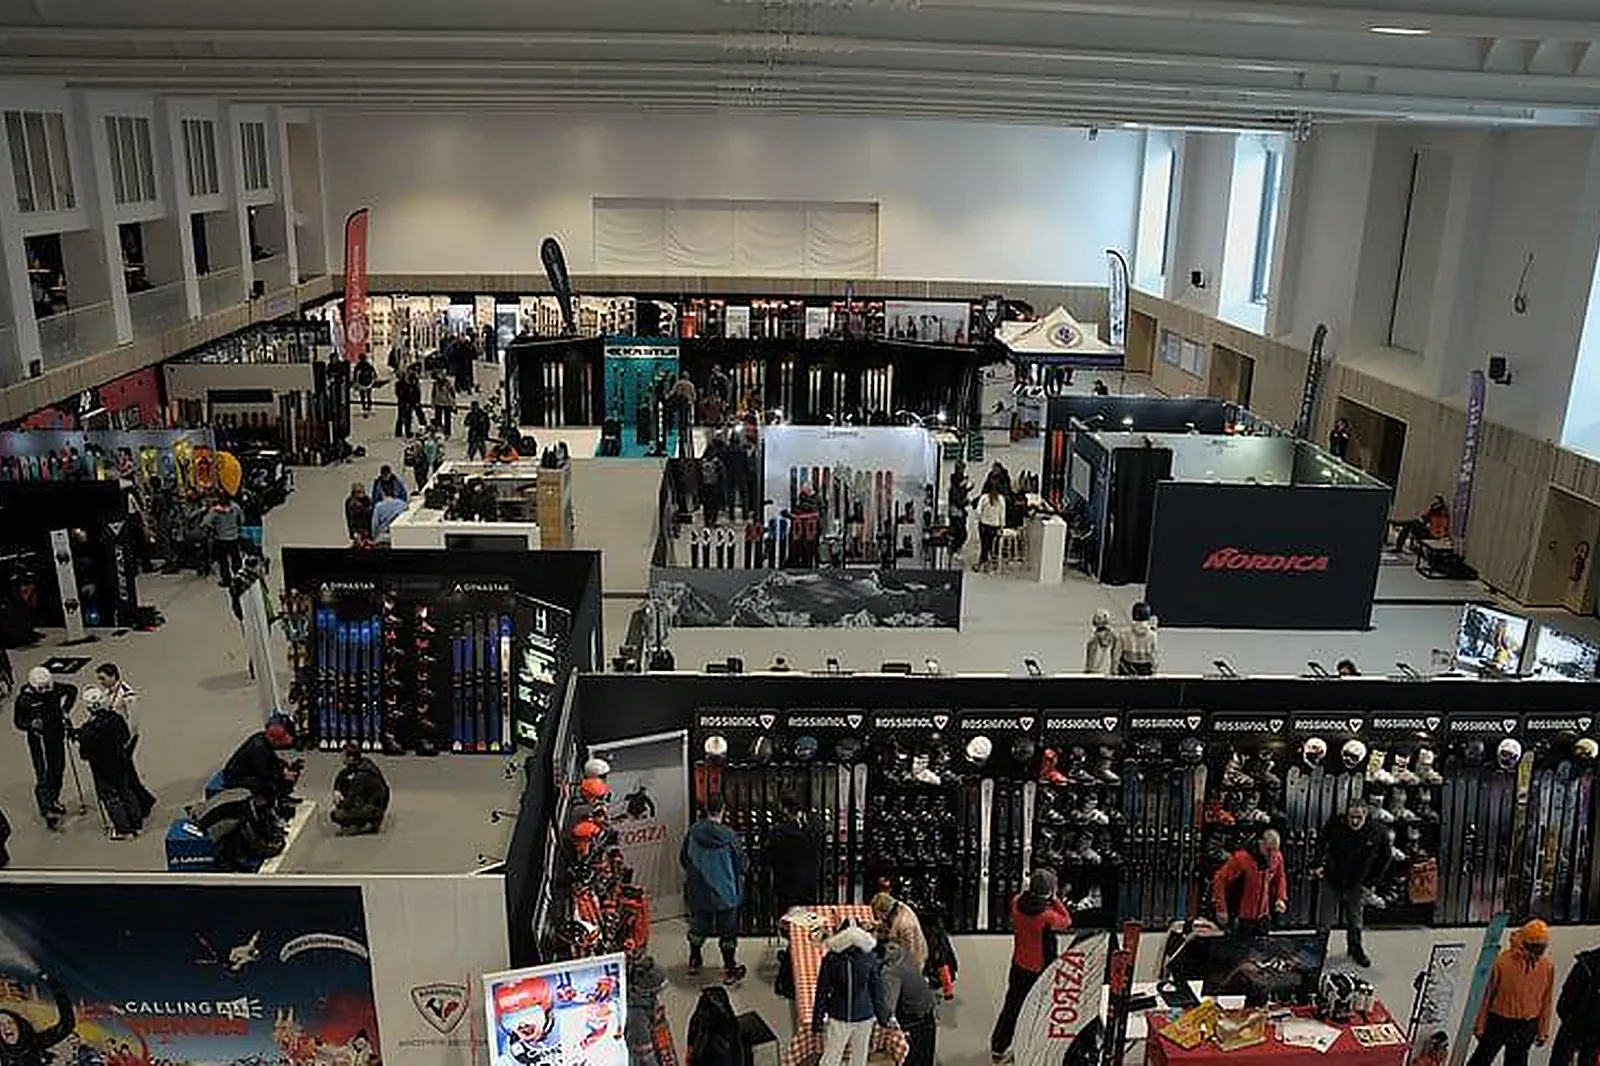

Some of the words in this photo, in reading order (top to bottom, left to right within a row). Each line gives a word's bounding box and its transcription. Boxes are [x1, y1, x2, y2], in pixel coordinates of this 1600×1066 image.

[1202, 548, 1328, 570] NORDICA
[1047, 951, 1086, 1039] FORZA
[125, 1001, 211, 1014] CALLING
